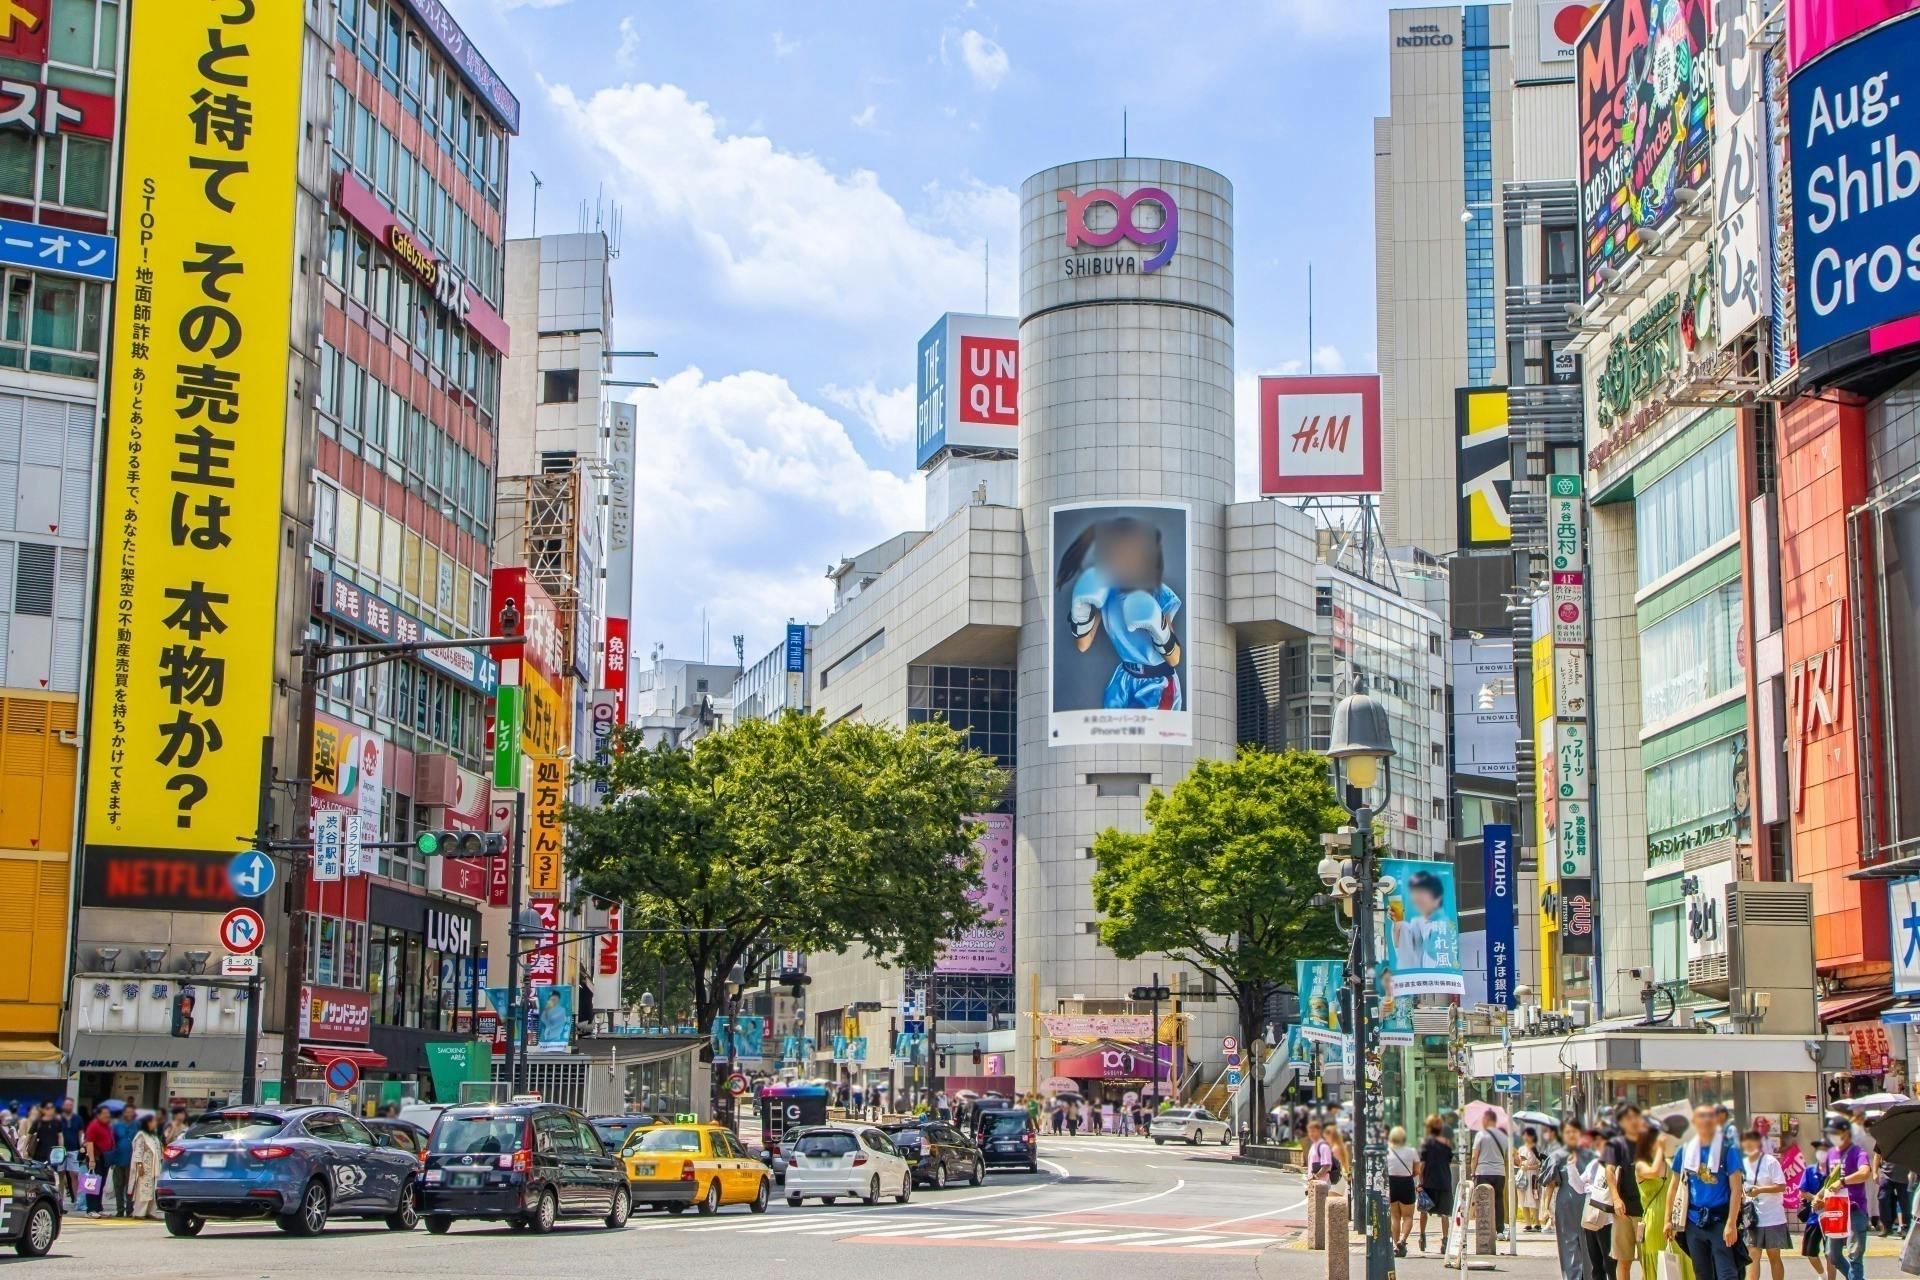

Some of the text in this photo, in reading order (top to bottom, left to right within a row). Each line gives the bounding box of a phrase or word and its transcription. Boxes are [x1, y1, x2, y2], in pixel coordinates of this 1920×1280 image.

[1396, 34, 1453, 48] INDIGO
[1409, 25, 1440, 33] HOTEL
[1807, 71, 1899, 148] Aug.
[1643, 110, 1672, 176] tinder
[1807, 133, 1920, 234] Shib
[0, 223, 107, 268] ーオン
[1057, 187, 1178, 273] 109
[1065, 256, 1135, 275] SHIBUYA
[924, 338, 939, 394] THE
[171, 241, 245, 551] その売主は
[918, 383, 944, 449] PRIME
[970, 384, 1019, 418] QL
[1291, 414, 1351, 454] H&M
[1558, 501, 1577, 555] 渋谷西村
[1560, 575, 1575, 584] 4F
[335, 581, 359, 619] 薄毛
[367, 599, 390, 634] 抜毛
[608, 636, 624, 672] 免税
[790, 632, 801, 670] THE PRIME
[479, 659, 496, 692] 4F
[156, 581, 230, 829] 本物か？
[523, 676, 561, 759] 処方せん
[499, 720, 511, 752] レイク
[312, 729, 337, 787] 薬
[1573, 739, 1584, 776] フルーツ
[535, 761, 560, 852] 処方せん
[325, 815, 338, 875] 渋谷駅前
[1563, 821, 1574, 859] フルーツ
[1576, 815, 1586, 856] 渋谷西村
[460, 867, 469, 889] 3F
[493, 839, 508, 885] コム
[539, 855, 552, 888] 3F
[1494, 839, 1507, 897] MIZUHO
[494, 888, 505, 897] 3F
[427, 908, 472, 956] LUSH
[468, 966, 487, 974] hur
[1493, 941, 1507, 1004] みずほ銀行
[328, 1002, 369, 1026] サンドラッグ
[79, 1060, 128, 1068] SHIBUYA
[134, 1060, 179, 1068] EKIMAE
[1101, 1051, 1134, 1073] 109
